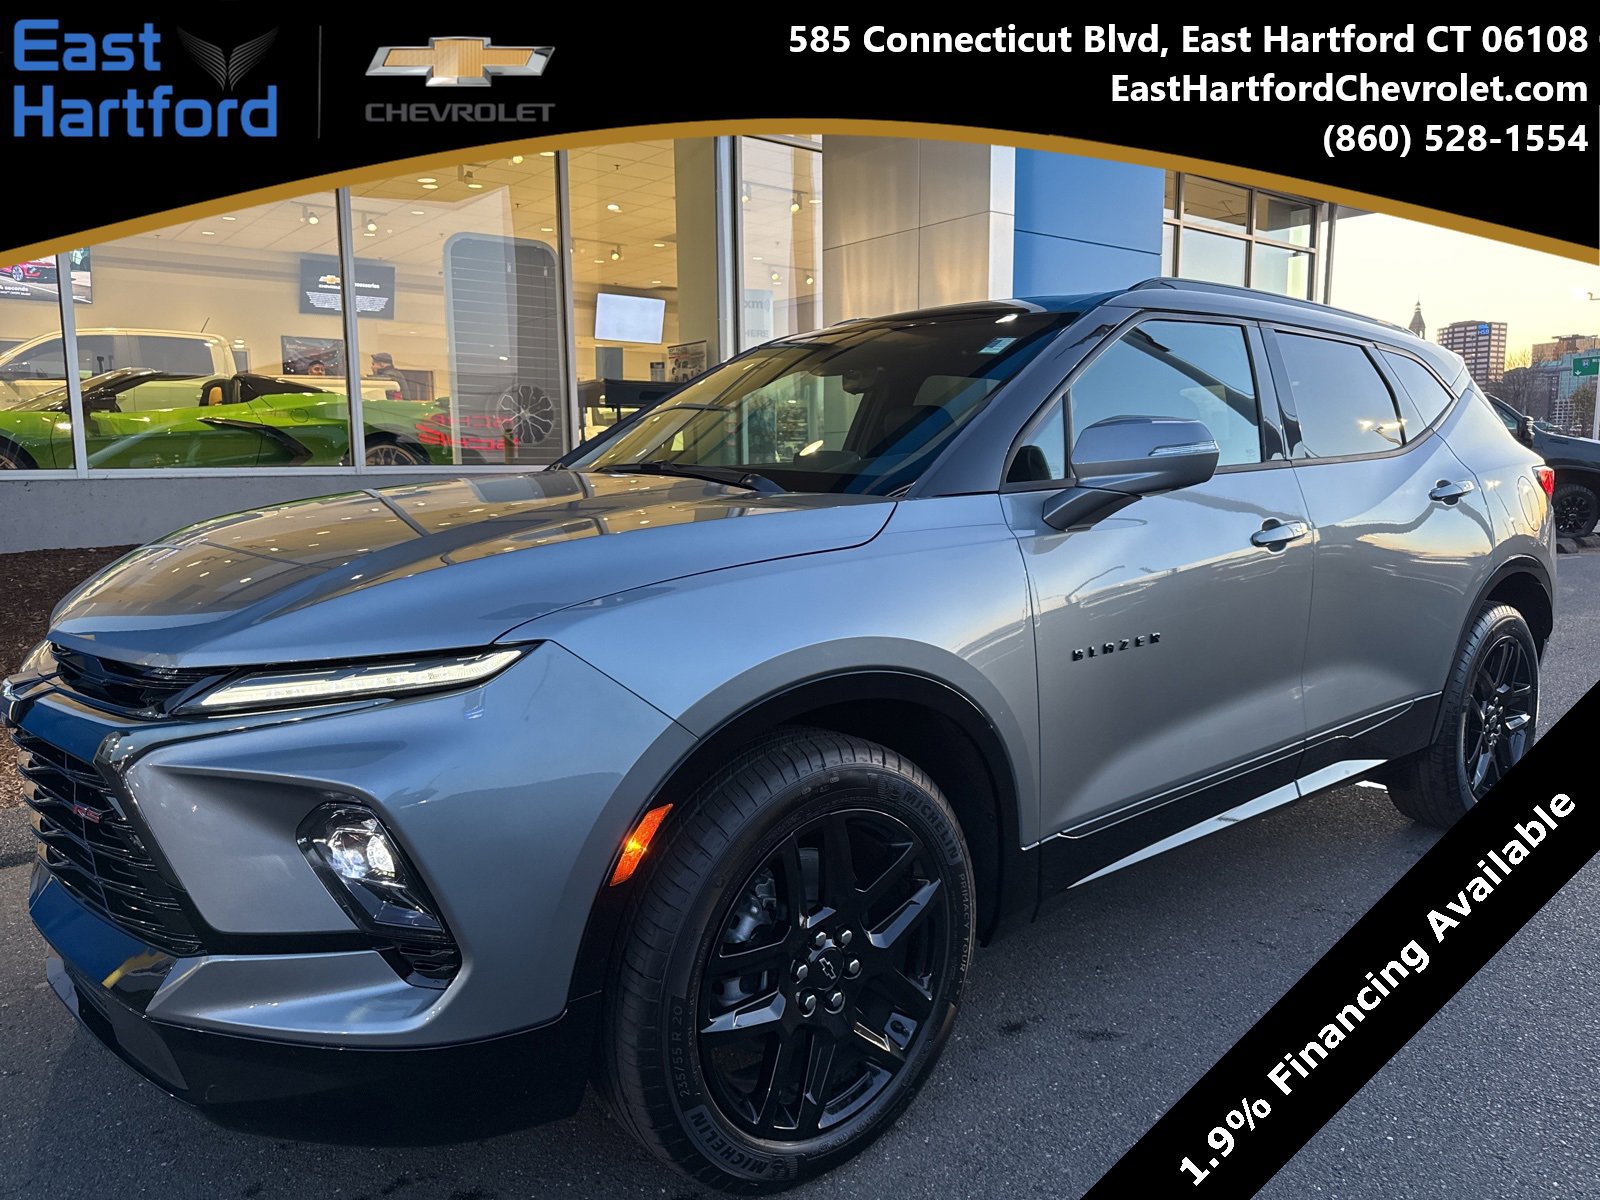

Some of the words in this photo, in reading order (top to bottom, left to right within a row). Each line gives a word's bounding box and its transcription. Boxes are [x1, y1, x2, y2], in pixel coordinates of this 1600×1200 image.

[1071, 632, 1161, 662] BLAZER
[902, 789, 961, 862] MICHELIN
[959, 872, 971, 930] PRIMACY
[959, 935, 970, 973] TOUR
[671, 1030, 683, 1041] R
[672, 1005, 683, 1026] 20
[671, 1046, 690, 1098] 235/55
[690, 1111, 769, 1175] MICHELIN
